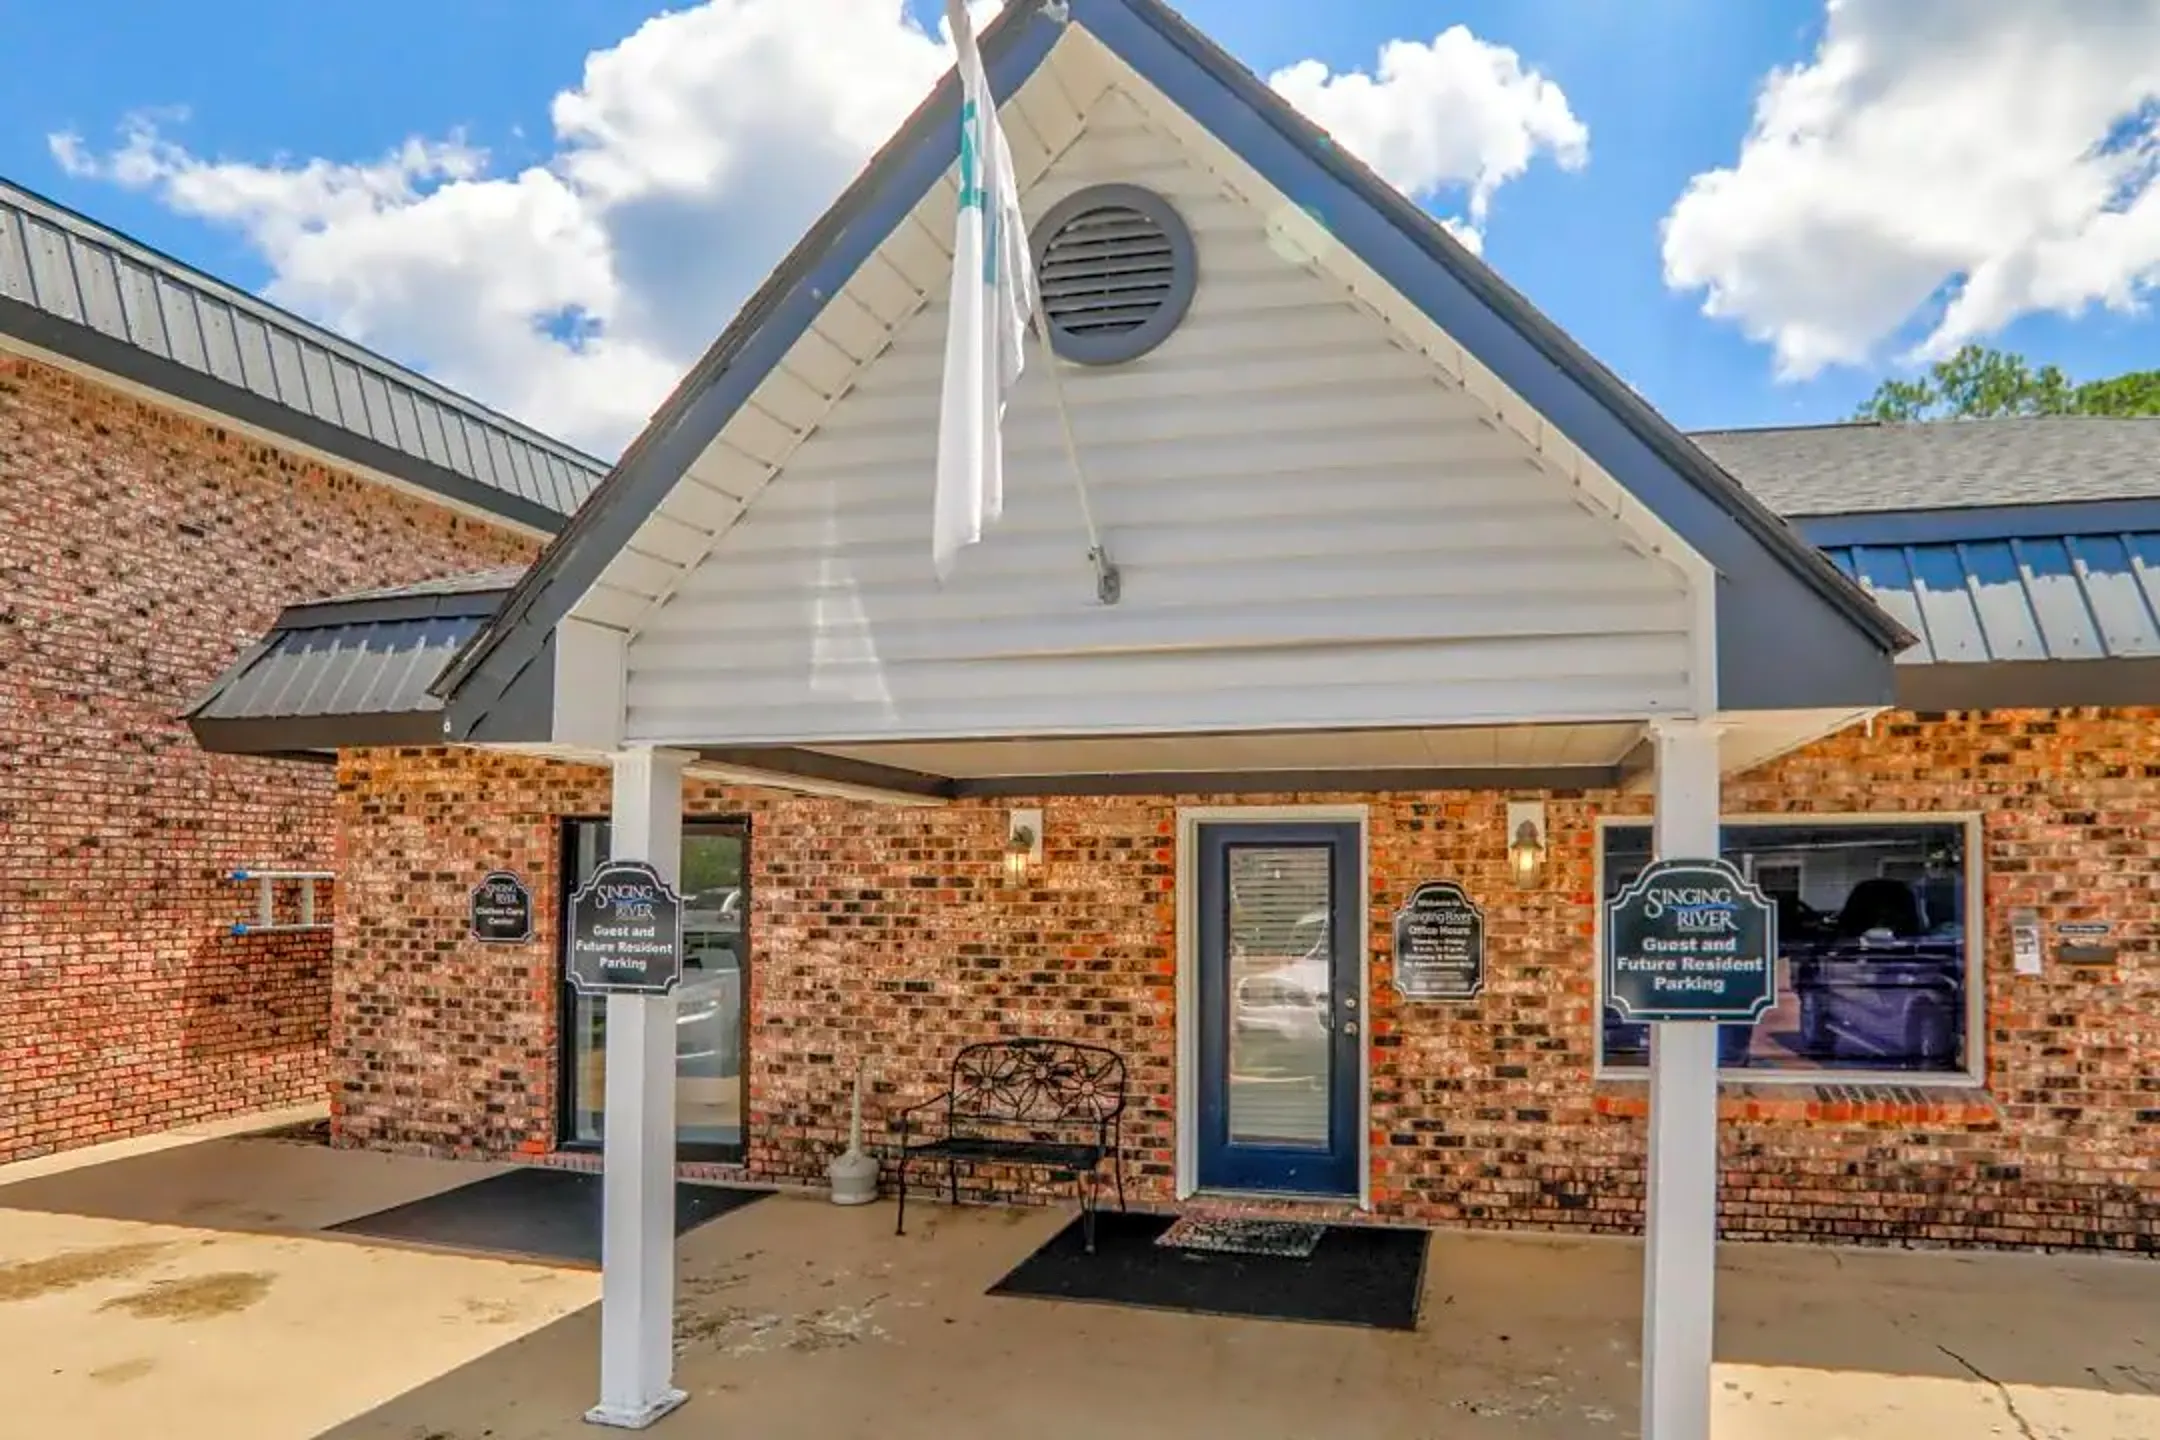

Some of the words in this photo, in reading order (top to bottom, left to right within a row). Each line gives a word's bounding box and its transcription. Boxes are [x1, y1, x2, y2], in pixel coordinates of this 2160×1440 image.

[595, 884, 653, 909] SINGING
[1644, 888, 1732, 919] SINGING
[615, 903, 656, 920] RIVER
[1677, 911, 1740, 931] RIVER
[593, 924, 629, 938] Guest
[631, 926, 655, 937] and
[1408, 925, 1438, 935] Office
[1440, 925, 1471, 936] Hours
[575, 940, 615, 953] Future
[618, 941, 673, 955] Resident
[1642, 936, 1698, 952] Guest
[1702, 937, 1736, 951] and
[599, 957, 647, 973] Parking
[1616, 957, 1677, 971] Future
[1682, 956, 1763, 972] Resident
[1654, 976, 1725, 993] Parking
